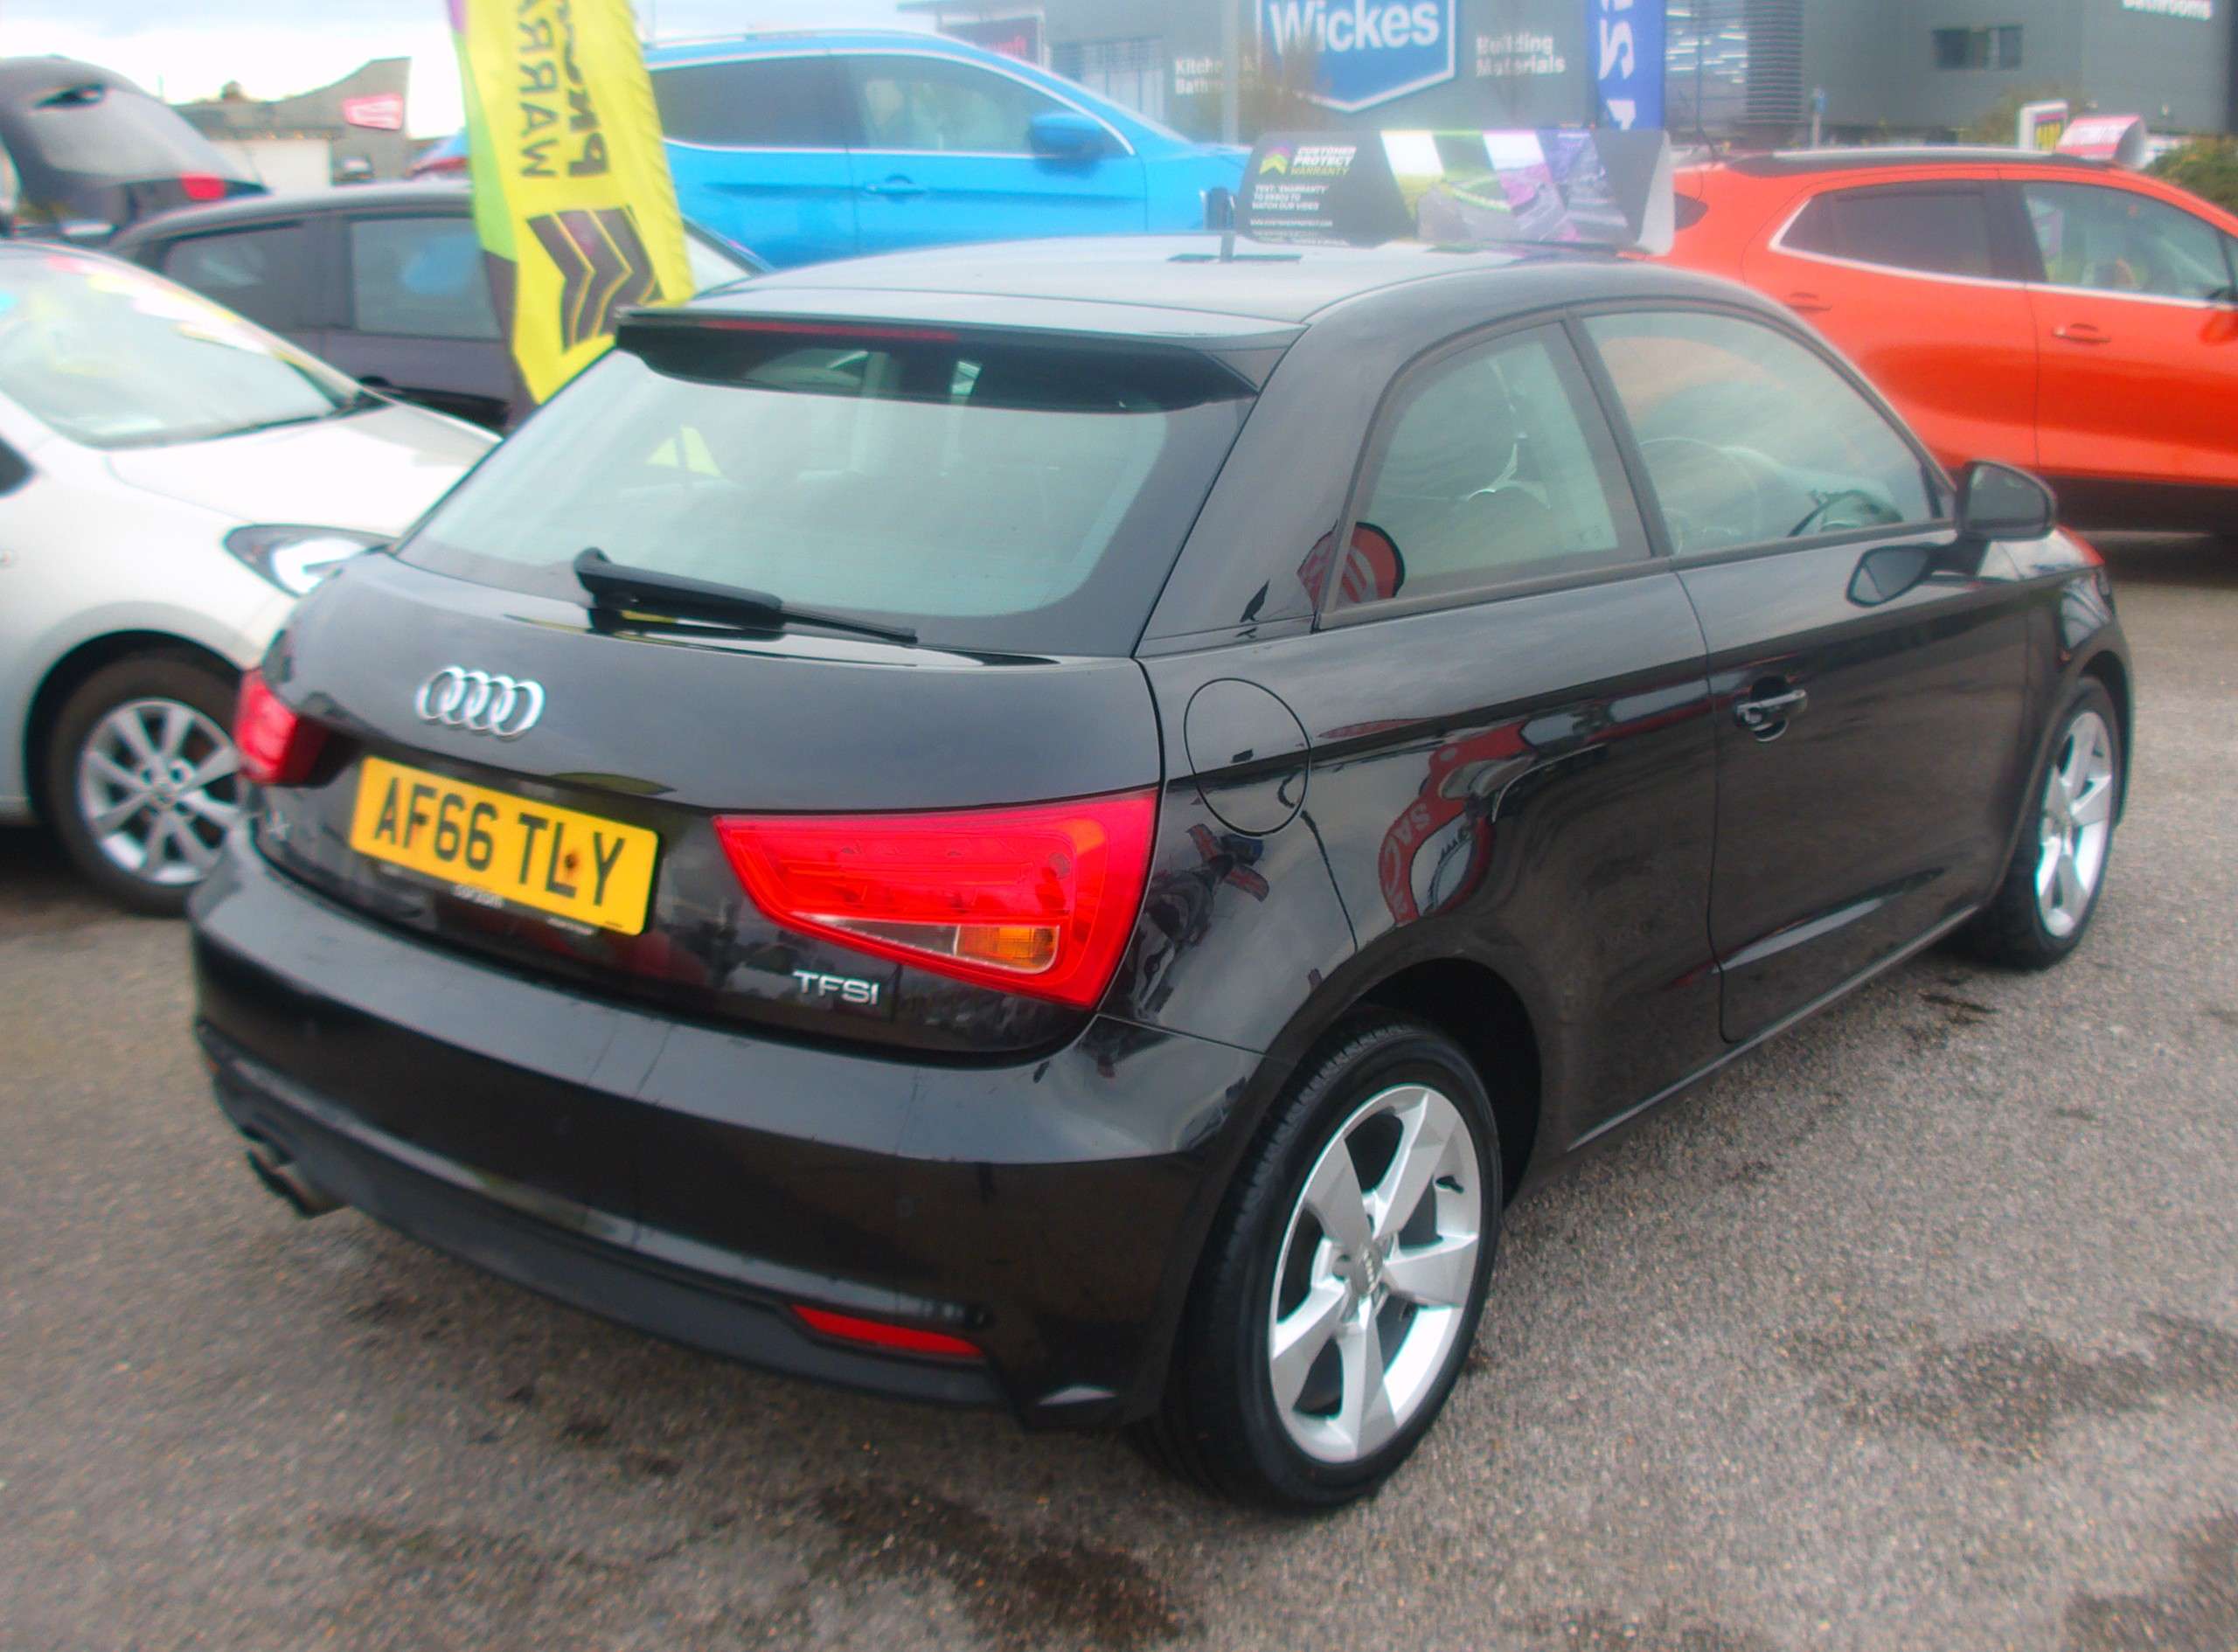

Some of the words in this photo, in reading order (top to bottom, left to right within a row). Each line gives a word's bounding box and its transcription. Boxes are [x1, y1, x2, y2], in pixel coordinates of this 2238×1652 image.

[1269, 0, 1440, 54] Wickes
[1290, 167, 1349, 176] WARRANTY
[1294, 155, 1352, 166] PROTECT
[374, 777, 499, 872] AF66
[518, 813, 625, 907] TLY
[792, 969, 879, 1005] TFSI
